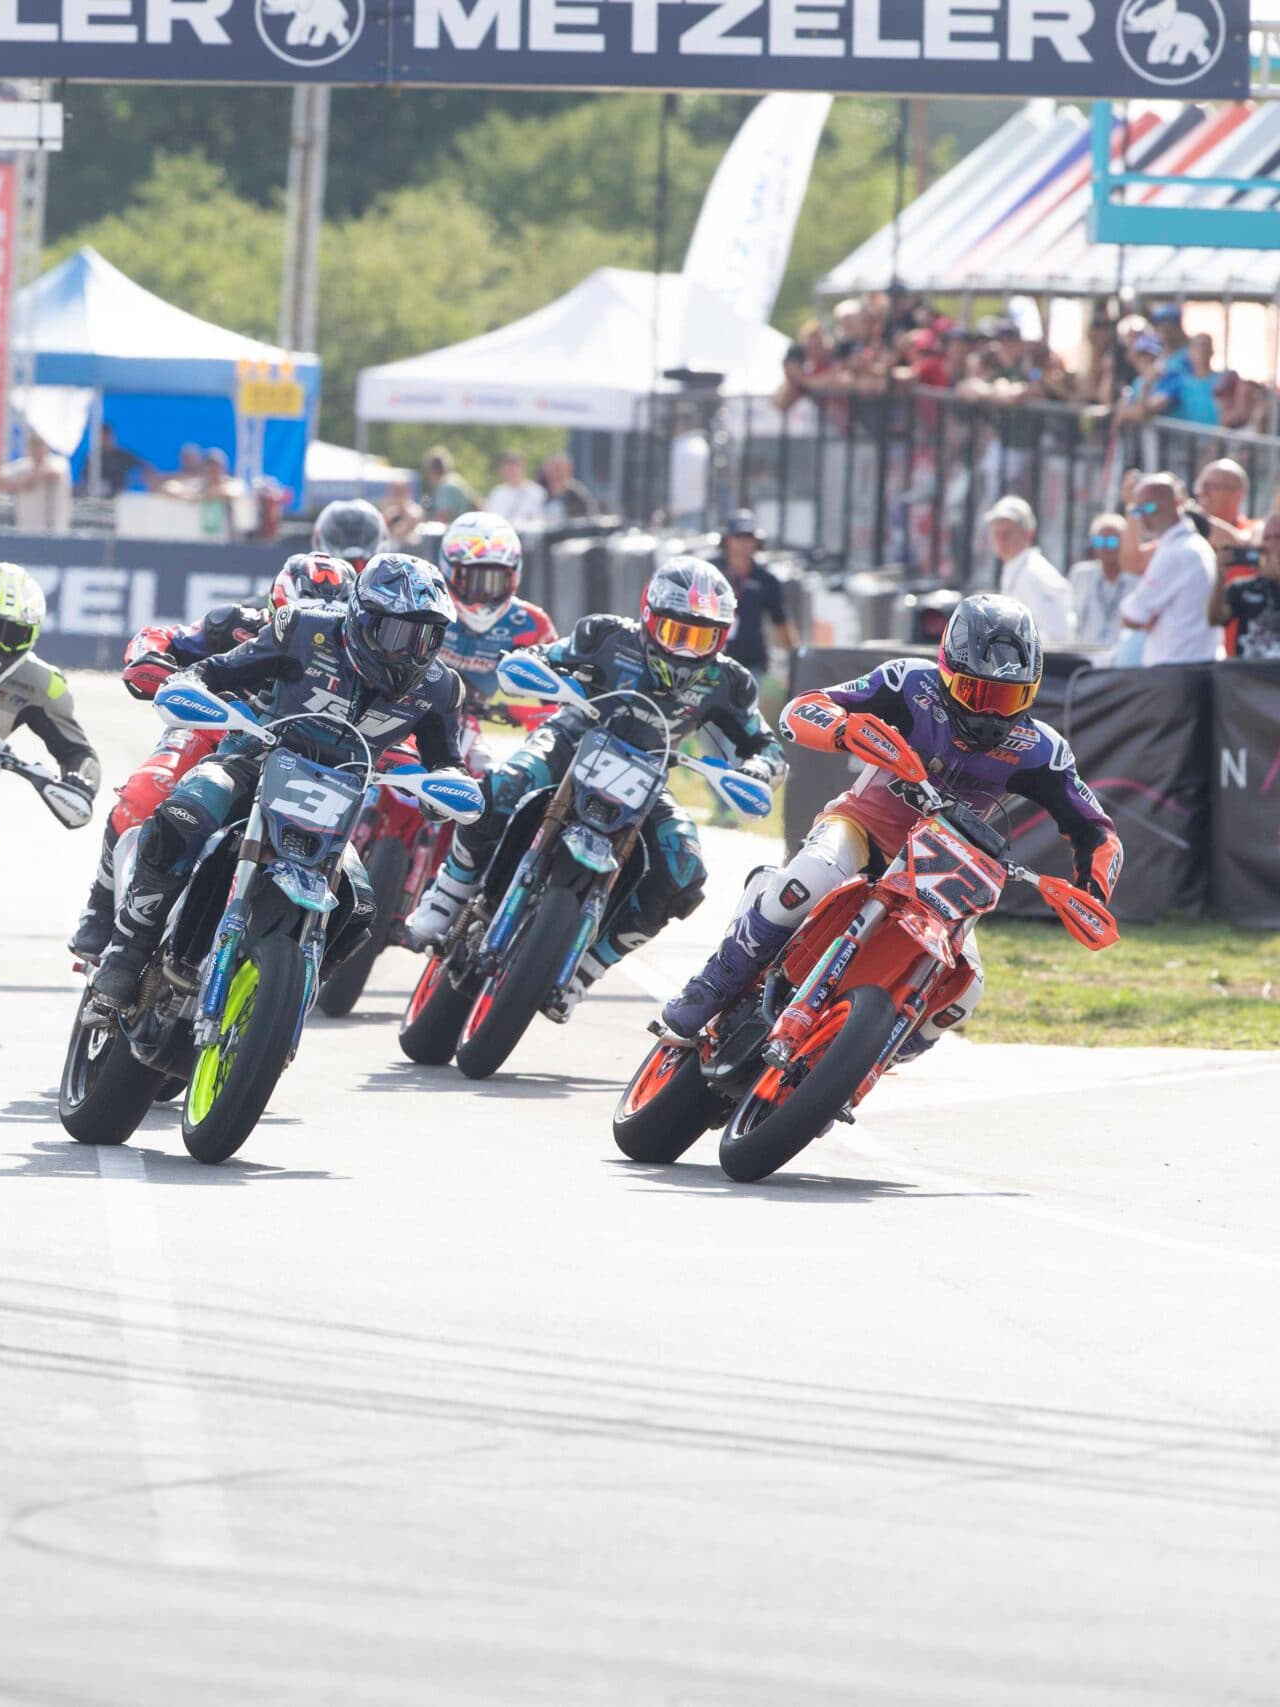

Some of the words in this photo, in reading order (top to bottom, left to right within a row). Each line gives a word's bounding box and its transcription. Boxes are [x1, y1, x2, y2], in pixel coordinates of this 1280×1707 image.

[413, 0, 1094, 63] METZELER
[181, 697, 225, 718] CIRCUIT
[792, 702, 837, 730] KTM
[1220, 747, 1248, 790] N
[269, 779, 353, 827] 3
[427, 783, 471, 800] CIRCUIT
[913, 830, 996, 915] 72
[817, 940, 858, 1002] METZER
